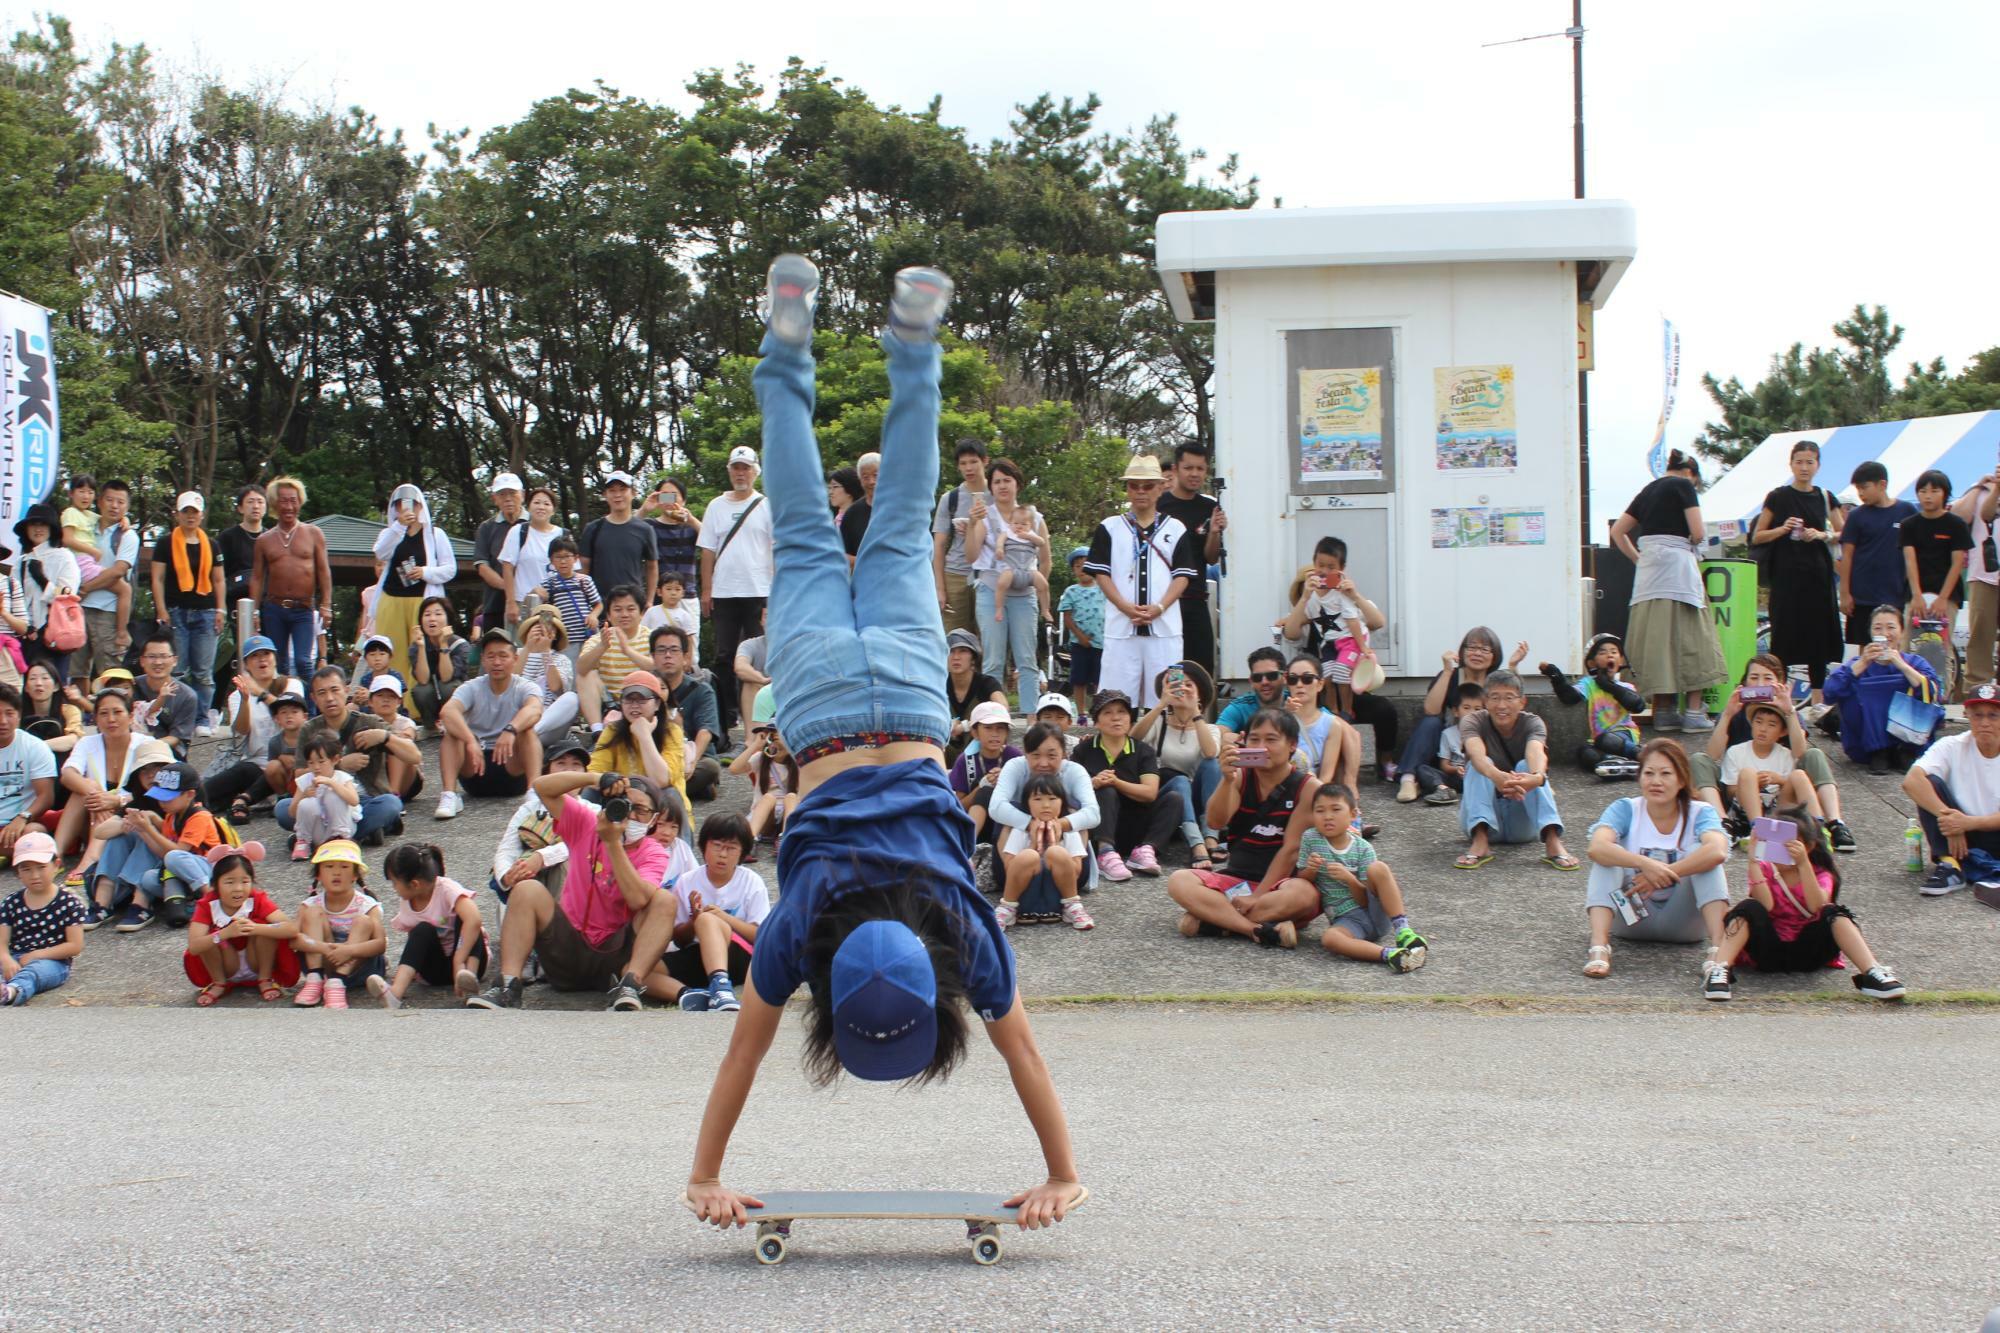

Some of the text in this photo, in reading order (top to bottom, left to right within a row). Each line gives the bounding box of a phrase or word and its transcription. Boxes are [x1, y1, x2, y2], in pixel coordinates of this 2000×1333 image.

[2, 336, 14, 519] ROLL WITH US
